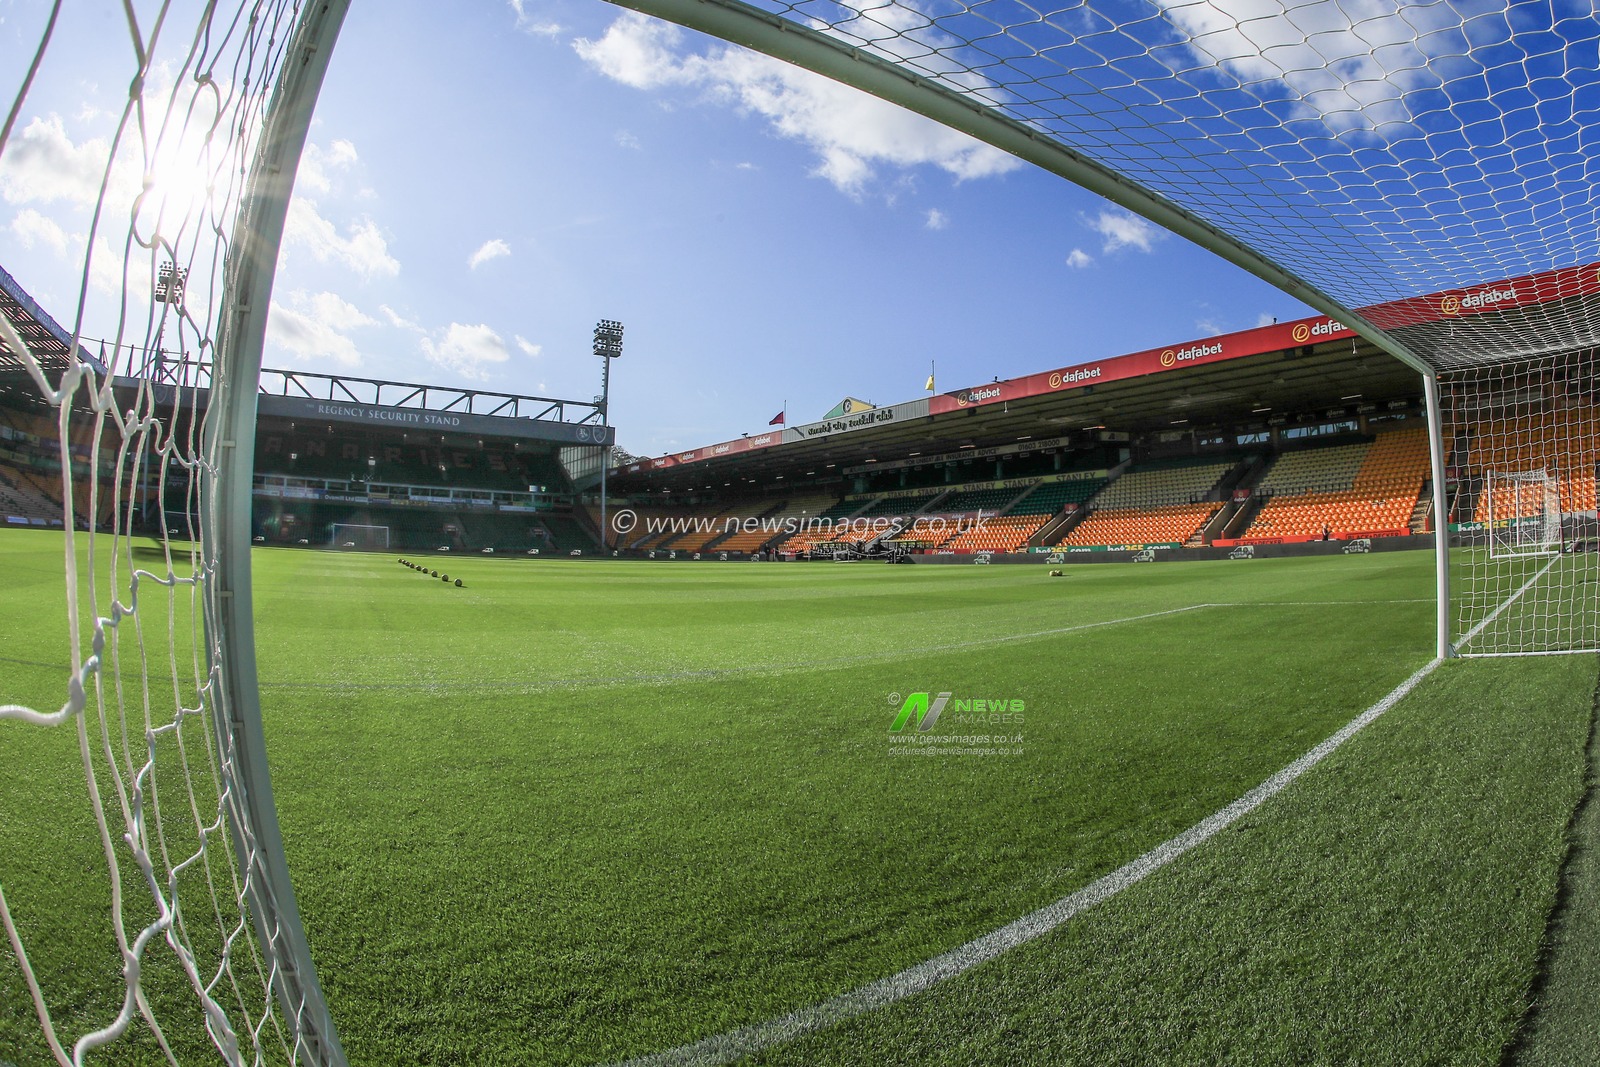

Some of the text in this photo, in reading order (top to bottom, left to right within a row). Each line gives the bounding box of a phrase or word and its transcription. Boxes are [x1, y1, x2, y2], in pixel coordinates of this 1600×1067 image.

[1461, 288, 1516, 308] dafabet
[1311, 319, 1348, 336] dafa
[1176, 342, 1223, 361] dafabet
[1062, 366, 1101, 383] dafabet
[968, 387, 1001, 402] dafabet
[318, 404, 365, 417] REGENCY
[368, 410, 421, 423] SECURITY
[424, 415, 460, 426] STAND
[807, 422, 832, 435] Norwich
[848, 412, 876, 428] Football
[876, 408, 894, 421] Club
[754, 436, 771, 446] dafabet
[945, 450, 976, 462] INSURANCE
[1017, 443, 1036, 452] 01603
[1038, 439, 1061, 448] 218000
[963, 477, 1040, 492] STANLEY STANLEY
[1055, 471, 1097, 482] STANLEY
[887, 486, 947, 499] STANLEY STANLEY
[1458, 520, 1540, 532] bet365com
